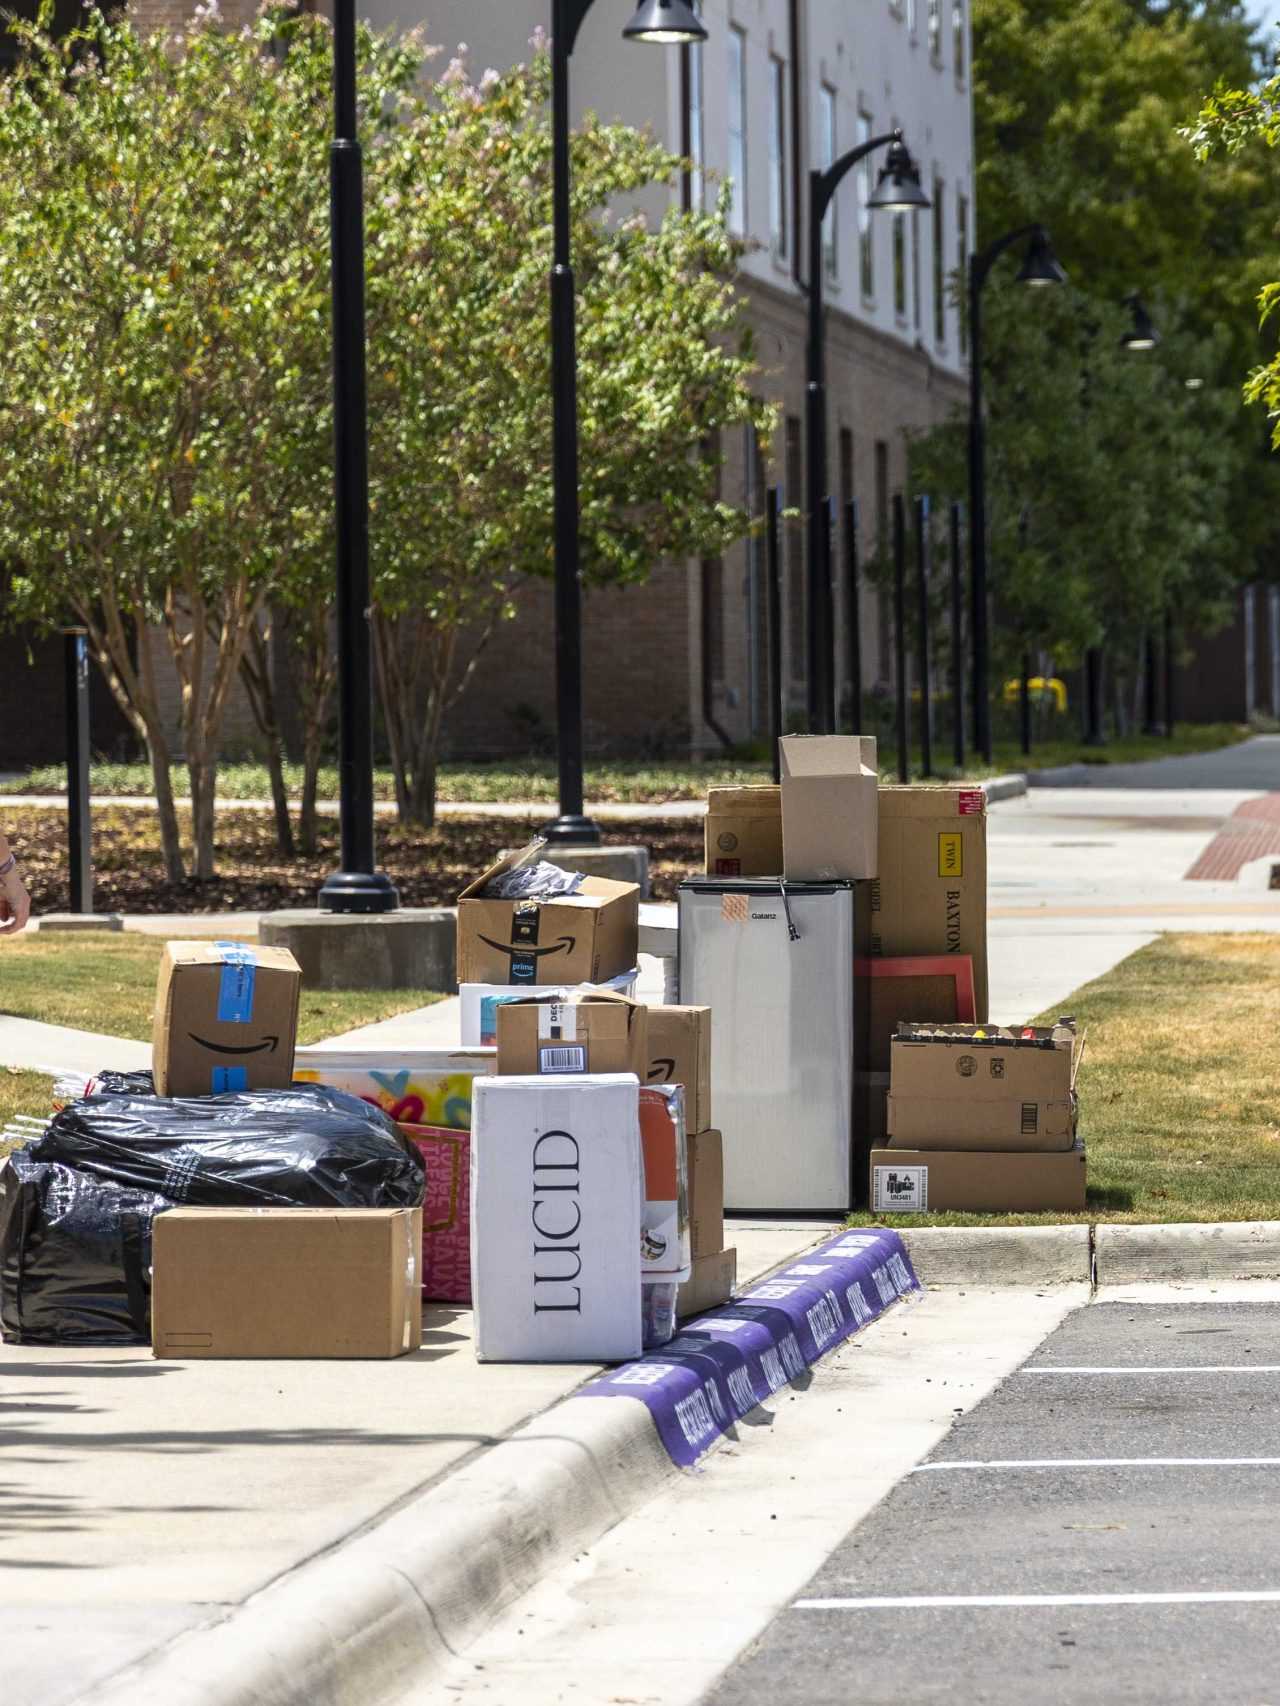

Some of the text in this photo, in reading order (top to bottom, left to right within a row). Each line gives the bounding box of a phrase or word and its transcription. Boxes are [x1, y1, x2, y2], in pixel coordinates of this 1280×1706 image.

[946, 840, 956, 869] TWIN
[946, 891, 961, 952] BAXTON
[511, 962, 534, 972] prime
[533, 1129, 581, 1315] LUCID
